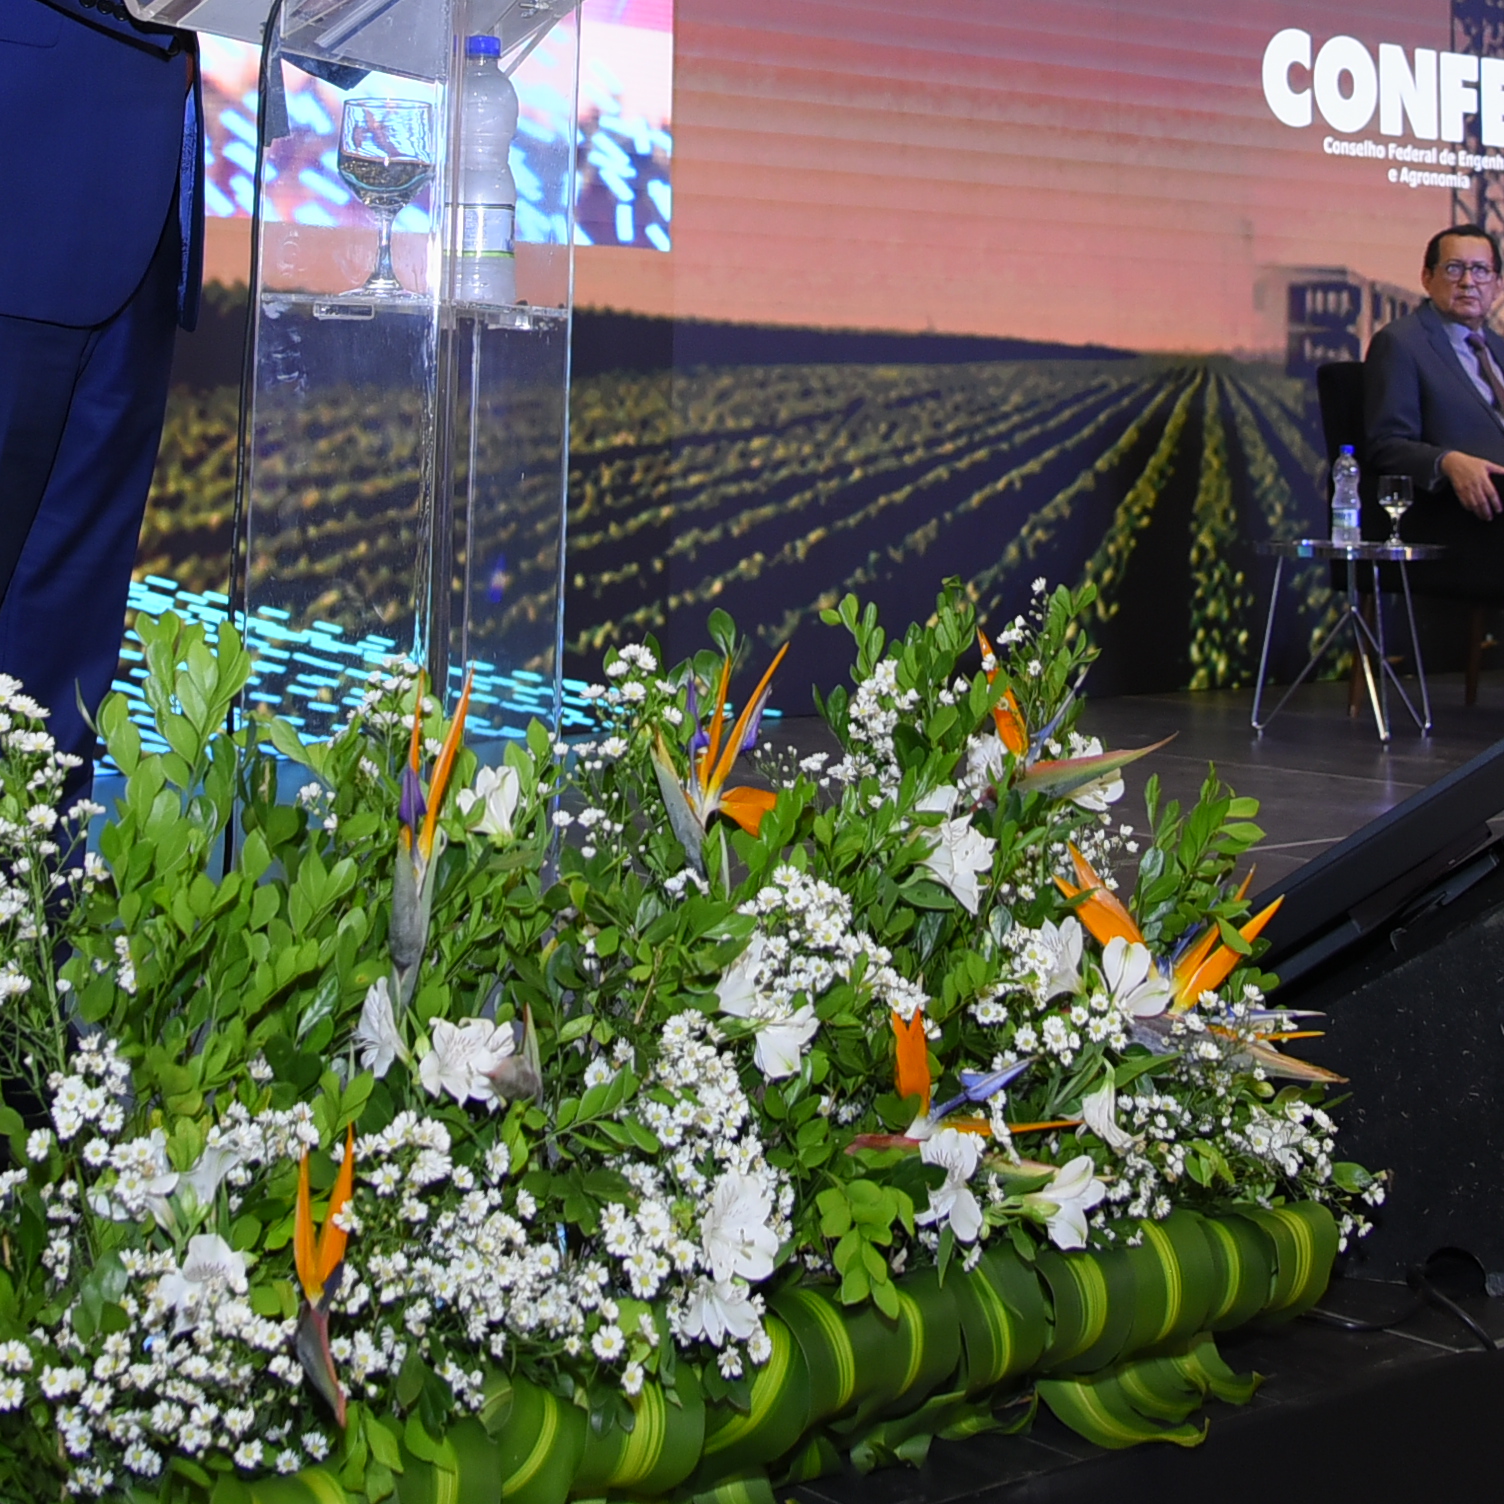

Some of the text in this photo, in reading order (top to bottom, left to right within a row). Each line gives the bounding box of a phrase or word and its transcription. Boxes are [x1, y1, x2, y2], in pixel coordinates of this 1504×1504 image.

[1323, 136, 1386, 159] Conselho
[1388, 143, 1437, 164] Federal
[1439, 148, 1457, 166] de
[1387, 166, 1471, 189] e Agronomia
